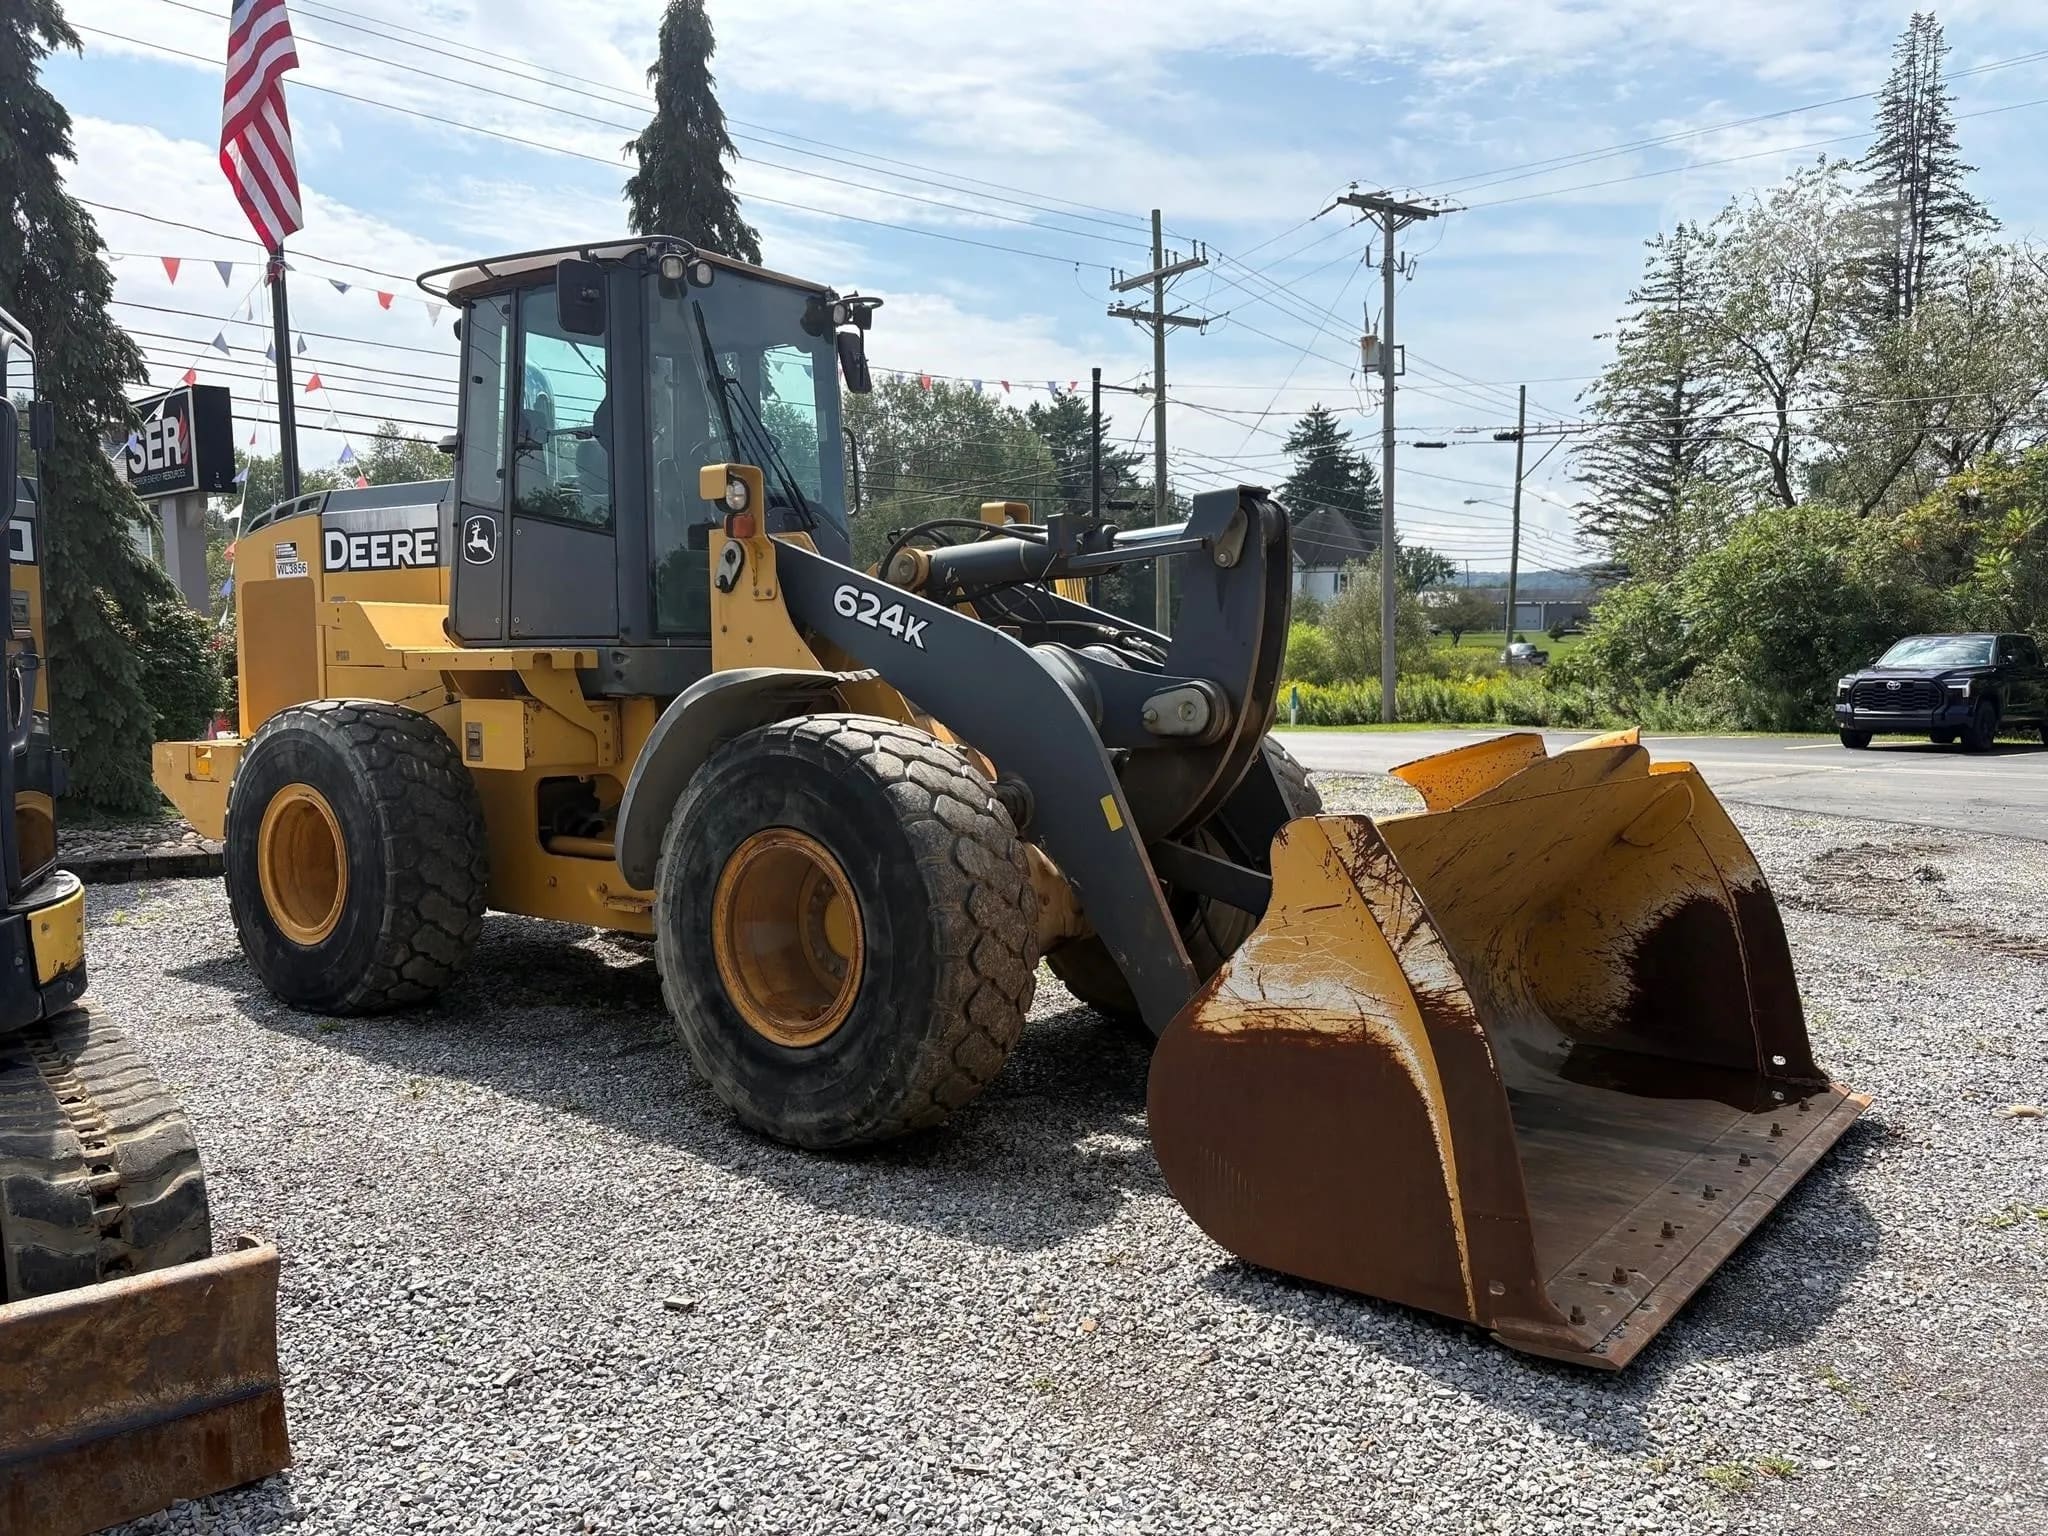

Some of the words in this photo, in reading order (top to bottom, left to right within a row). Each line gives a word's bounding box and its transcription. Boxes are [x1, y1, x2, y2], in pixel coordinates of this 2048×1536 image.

[277, 562, 307, 575] WL3856
[324, 531, 437, 570] DEERE
[833, 584, 929, 649] 624K
